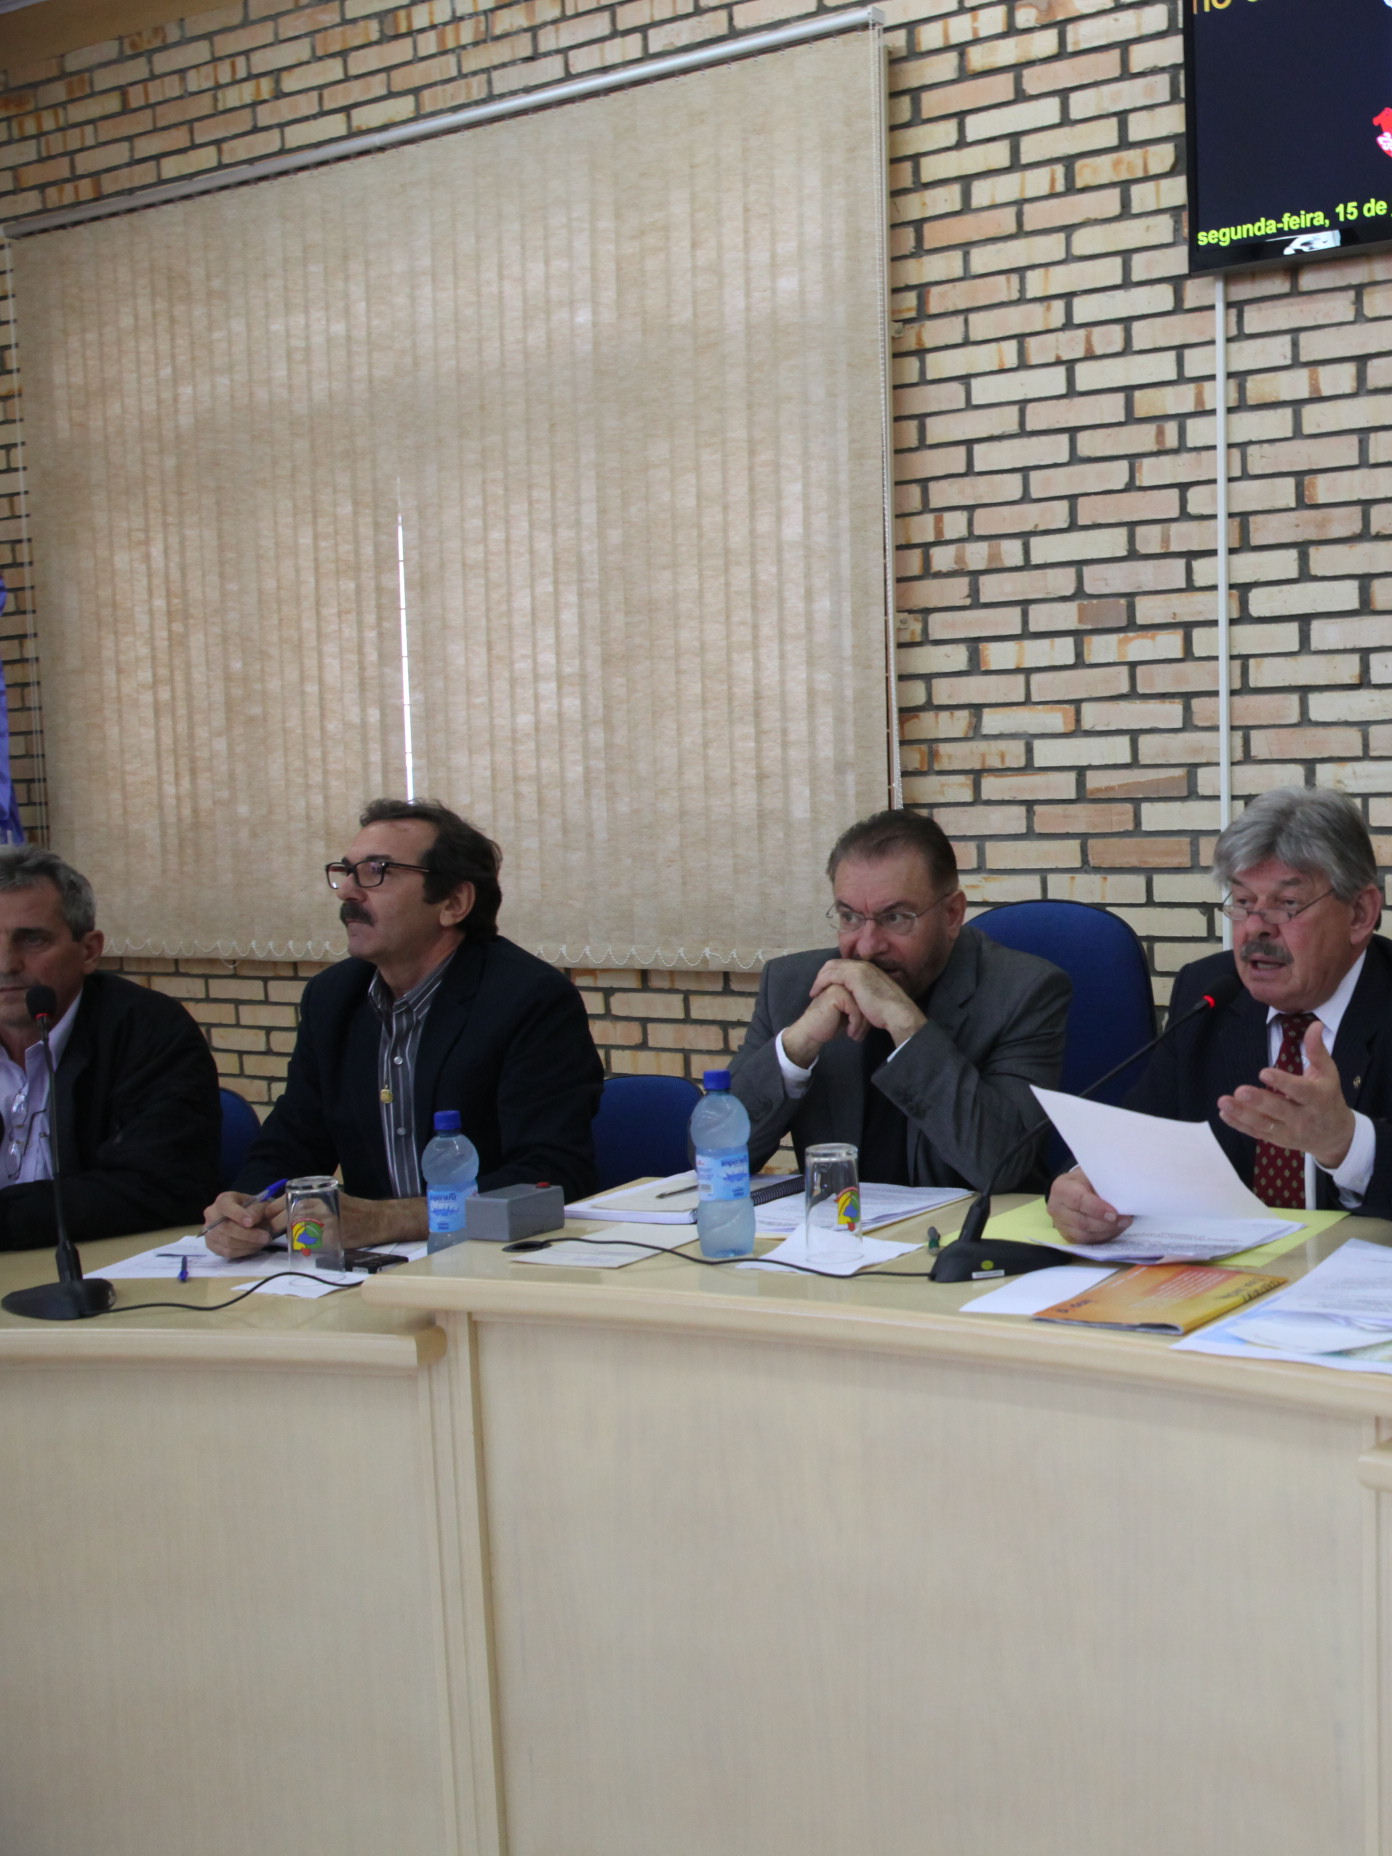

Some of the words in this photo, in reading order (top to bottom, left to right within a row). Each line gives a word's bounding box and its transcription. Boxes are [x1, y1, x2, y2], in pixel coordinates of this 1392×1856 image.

[1197, 210, 1330, 246] segunda-feira,
[1335, 201, 1359, 222] 15
[1362, 197, 1388, 218] de
